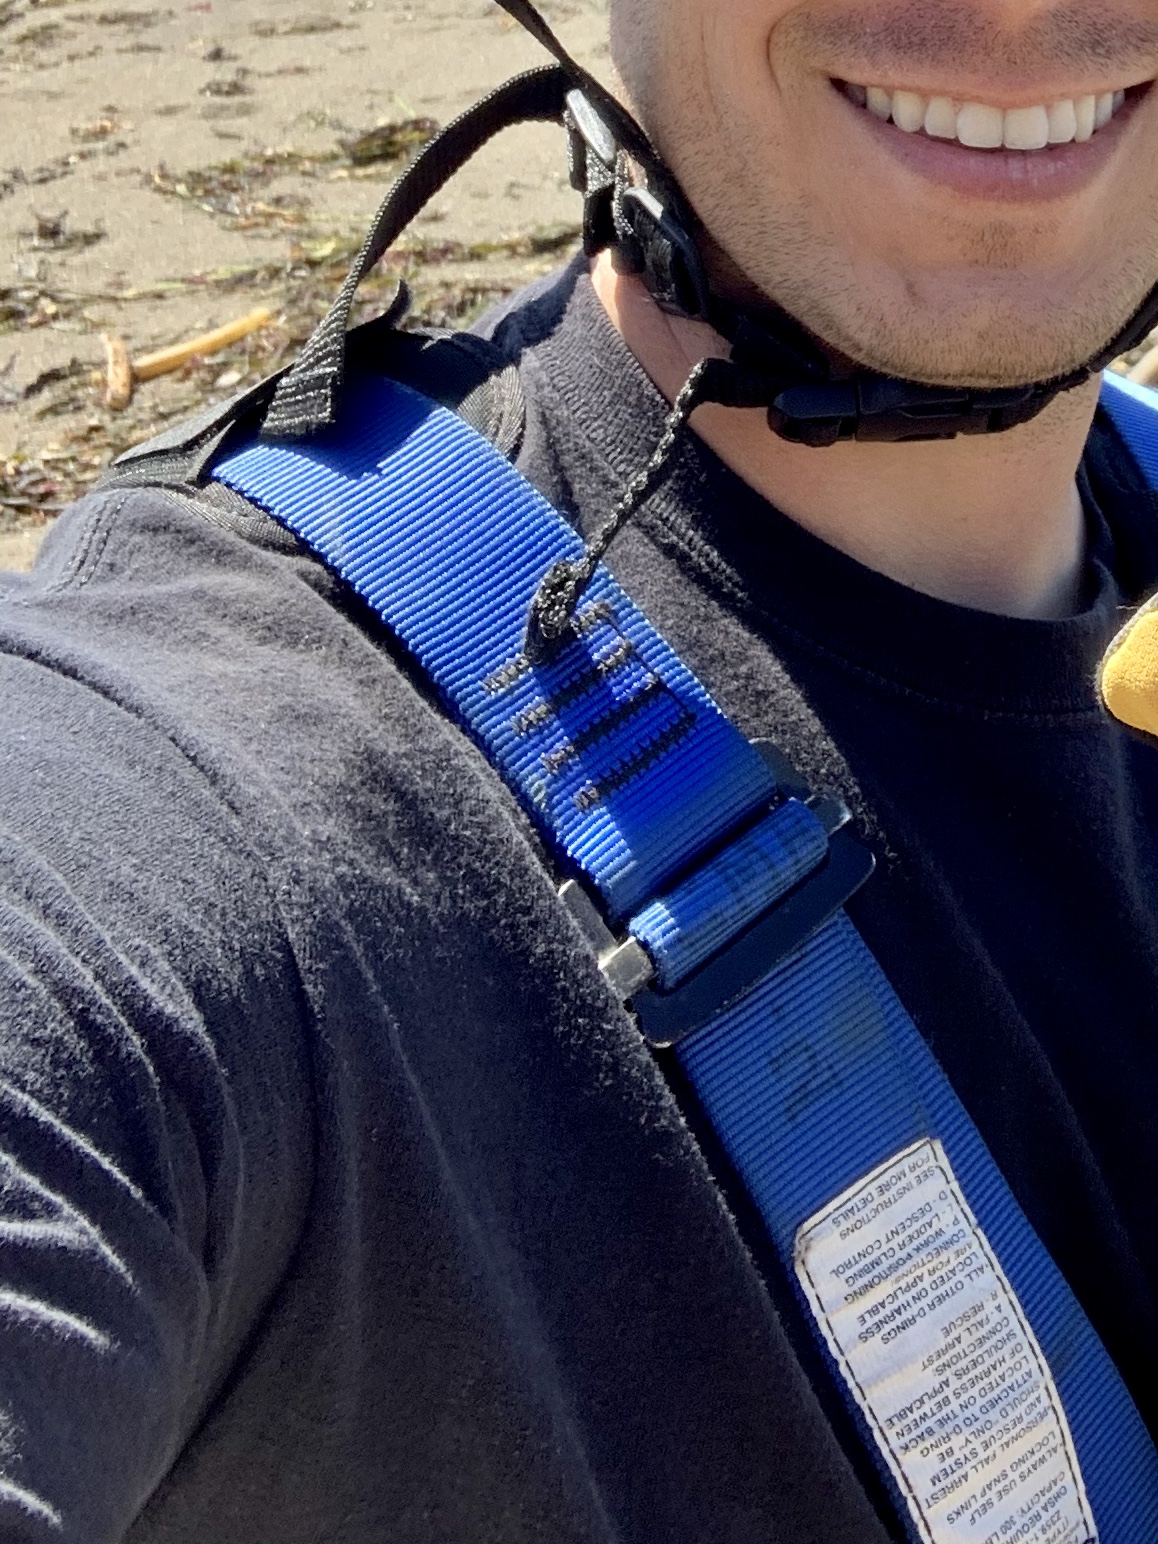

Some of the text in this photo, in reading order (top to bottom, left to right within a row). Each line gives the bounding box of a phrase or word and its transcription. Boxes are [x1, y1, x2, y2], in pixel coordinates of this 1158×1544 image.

[831, 1152, 930, 1228] FOR MORE DETAILS
[839, 1165, 935, 1240] SEE INSTRUCTIONS
[938, 1190, 948, 1201] D
[885, 1202, 933, 1244] DESCENT
[897, 1213, 941, 1251] LADDER
[912, 1227, 946, 1254] WORK
[829, 1239, 882, 1278] CONTROL
[843, 1252, 913, 1305] POSITIONING
[844, 1247, 896, 1287] CLIMBING
[927, 1256, 951, 1277] FOR
[857, 1272, 924, 1327] APPLICABLE
[858, 1251, 979, 1343] LOCATED ON HARNESS
[880, 1264, 985, 1345] ALL OTHER D-RINGS
[994, 1303, 1002, 1314] A
[940, 1301, 985, 1339] RESCUE
[963, 1313, 990, 1337] FALL
[921, 1332, 962, 1372] ARREST
[884, 1376, 950, 1430] APPLICABLE
[895, 1342, 1024, 1440] OF HARNESS BETWEEN
[899, 1355, 1030, 1455] LOCATED ON THE BACK
[999, 1380, 1041, 1419] SHOULD
[920, 1368, 1033, 1458] ATTACHED TO D-RING
[929, 1393, 1042, 1487] AND RESCUE SYSTEM
[936, 1446, 955, 1464] BE
[946, 1430, 1056, 1525] LOCKING SNAP LINKS
[970, 1450, 997, 1474] FALL
[924, 1471, 969, 1510] ARREST
[969, 1444, 1058, 1526] ALWAYS USE SELF
[1040, 1485, 1068, 1513] OHSA
[999, 1515, 1017, 1536] 300
